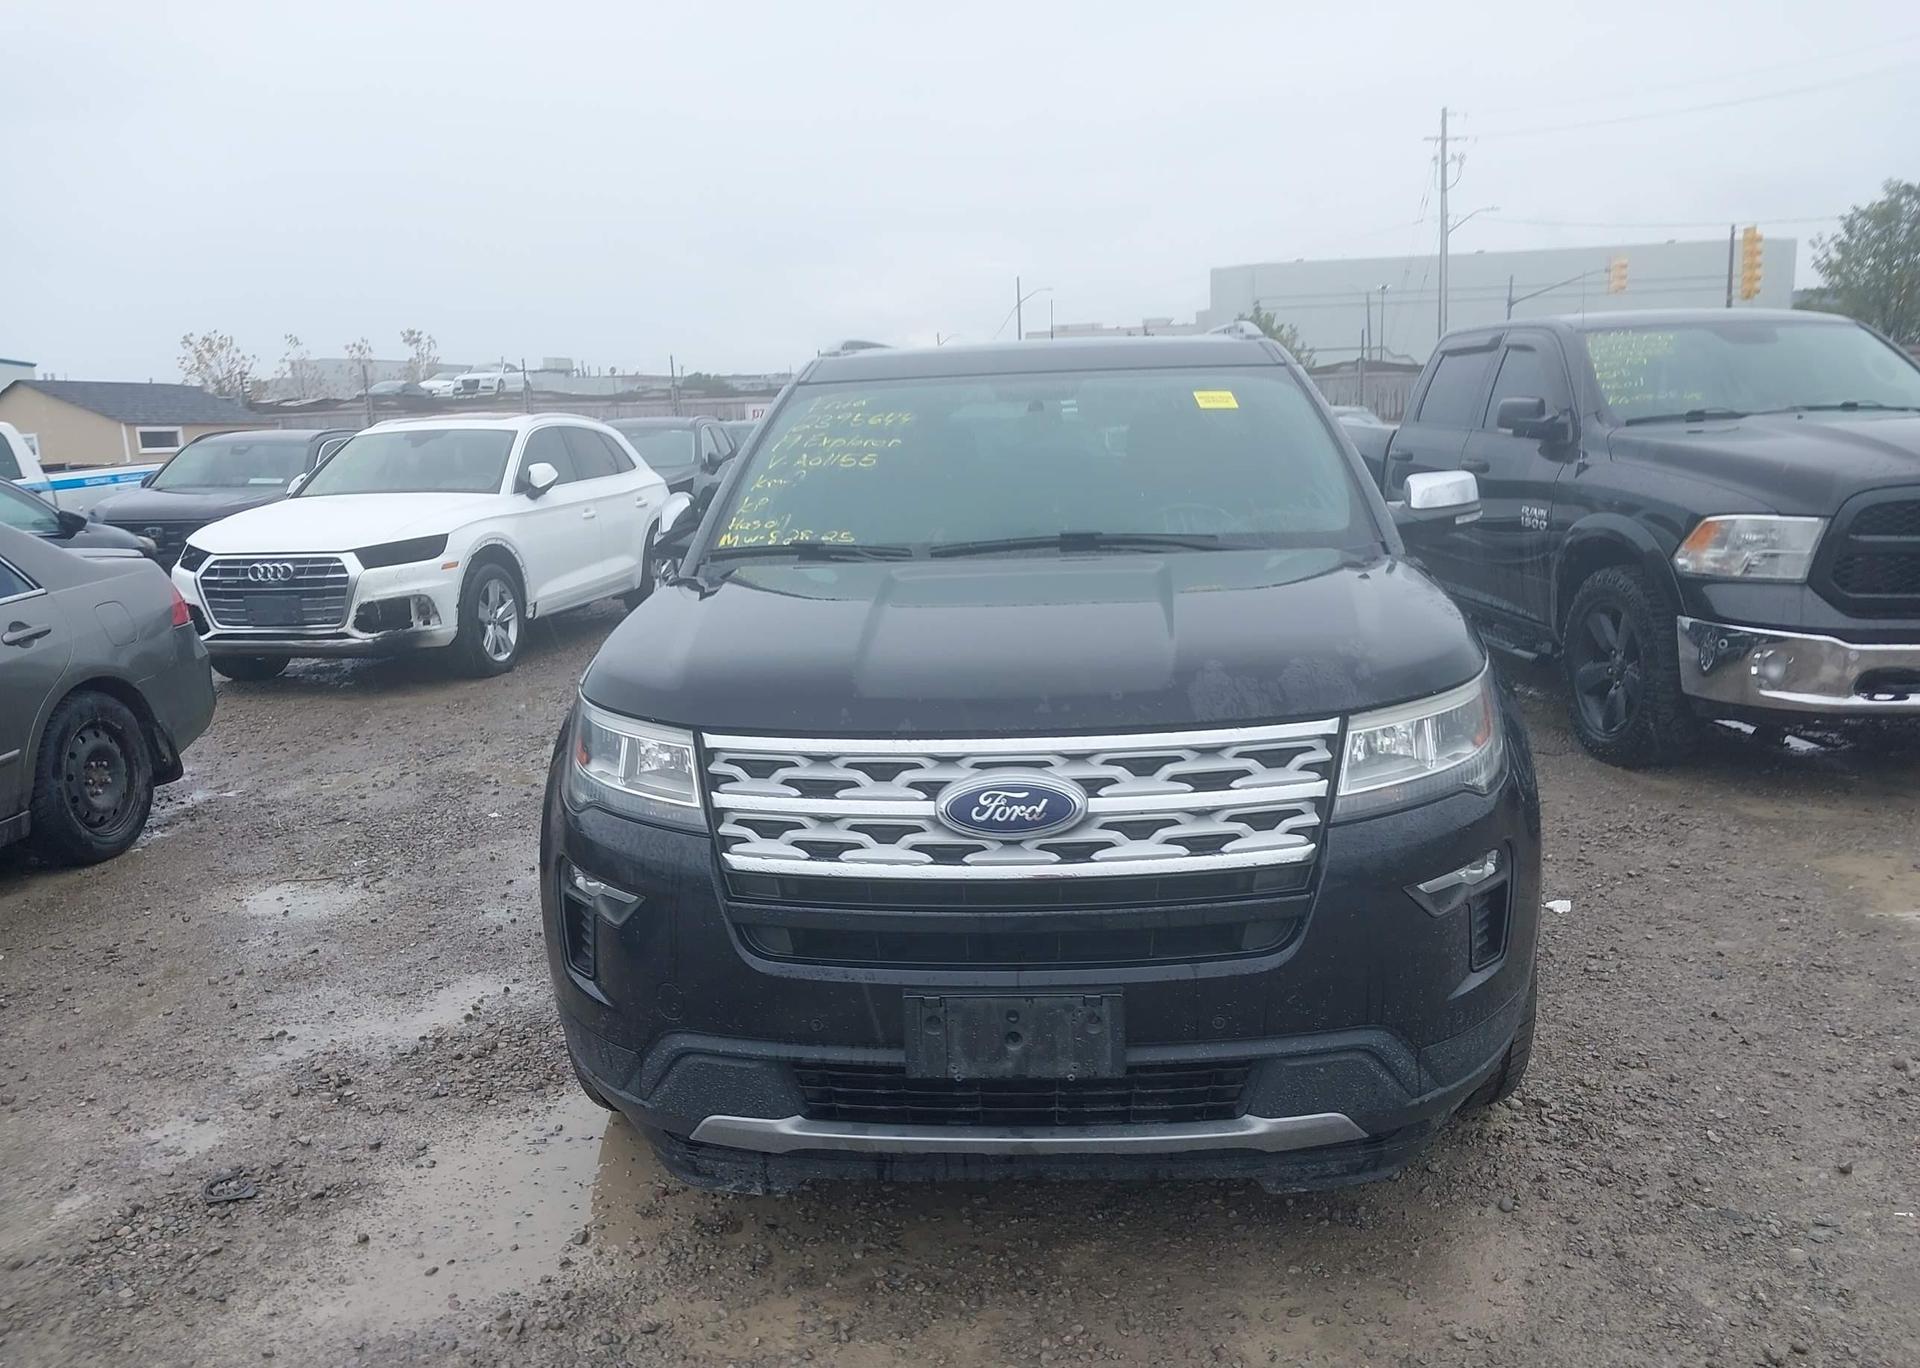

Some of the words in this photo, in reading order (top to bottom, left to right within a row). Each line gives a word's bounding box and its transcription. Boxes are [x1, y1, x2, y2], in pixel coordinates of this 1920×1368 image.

[1521, 505, 1549, 520] RAM
[1521, 516, 1548, 530] 1500
[971, 790, 1048, 822] Ford
